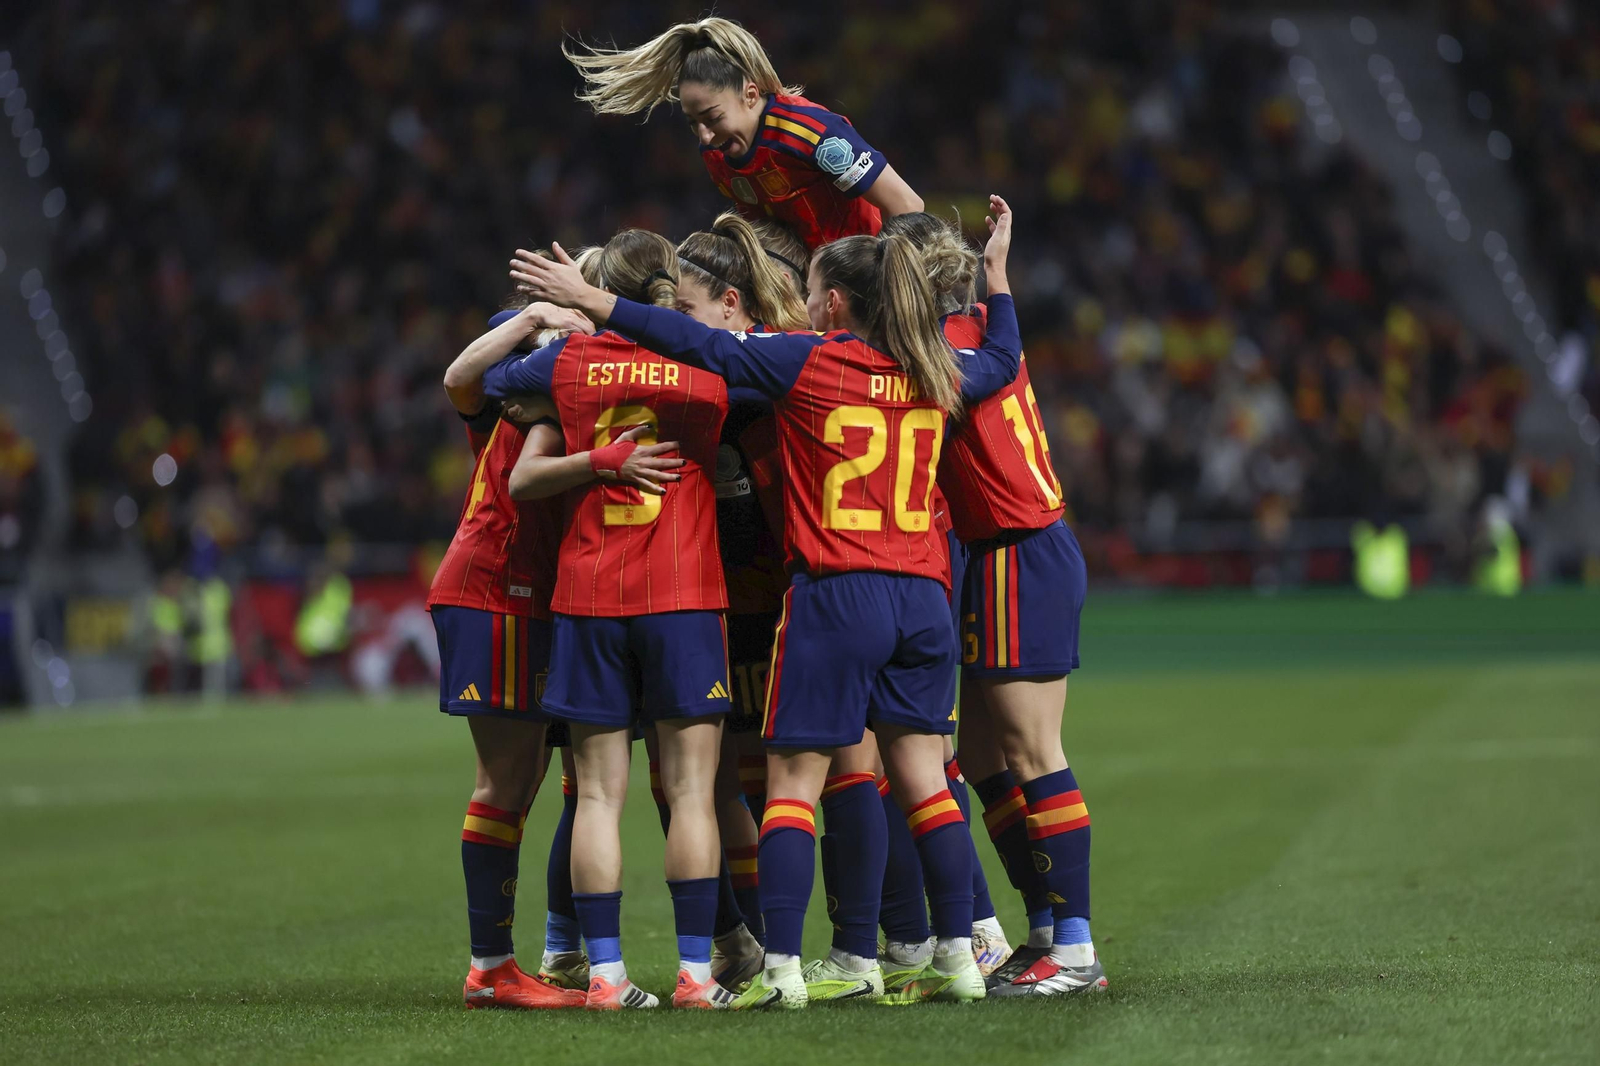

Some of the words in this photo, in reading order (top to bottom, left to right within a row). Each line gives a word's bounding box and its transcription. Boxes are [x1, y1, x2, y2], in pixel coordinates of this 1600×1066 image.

[587, 362, 679, 387] ESTHER
[870, 374, 919, 403] PINA
[823, 405, 944, 532] 20
